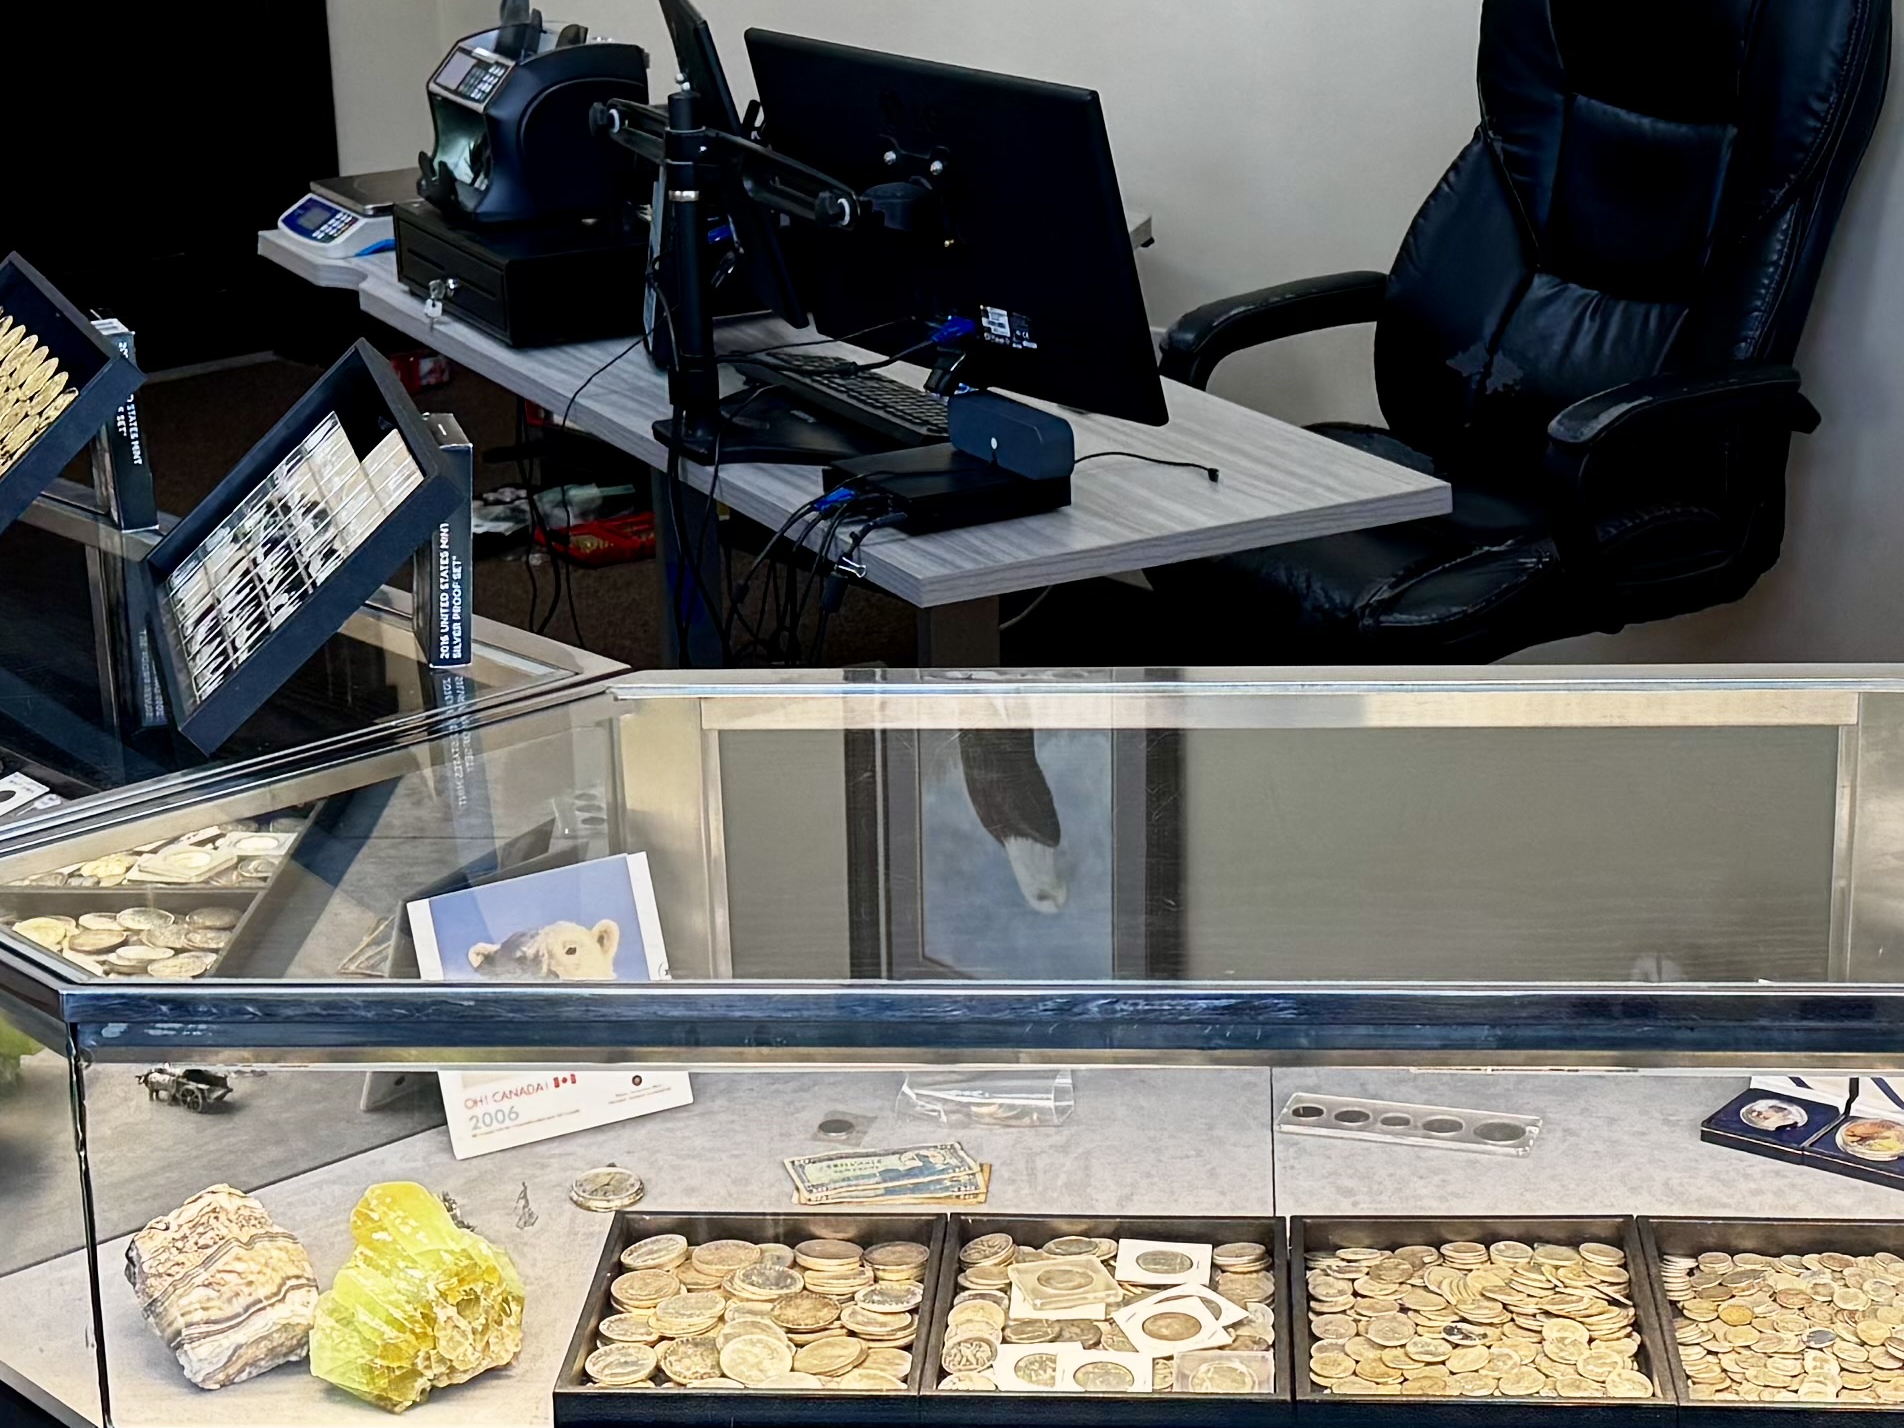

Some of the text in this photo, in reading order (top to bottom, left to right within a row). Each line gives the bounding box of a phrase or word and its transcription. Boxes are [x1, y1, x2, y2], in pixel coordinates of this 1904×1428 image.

[126, 403, 139, 440] STATES
[131, 440, 143, 465] MINT
[439, 522, 450, 549] MINT
[439, 550, 450, 590] STATES
[439, 592, 450, 633] UNITED
[452, 582, 462, 621] PROOF
[452, 622, 462, 659] SILVER
[464, 1080, 549, 1110] OH! CANADA!
[469, 1105, 520, 1131] 2006
